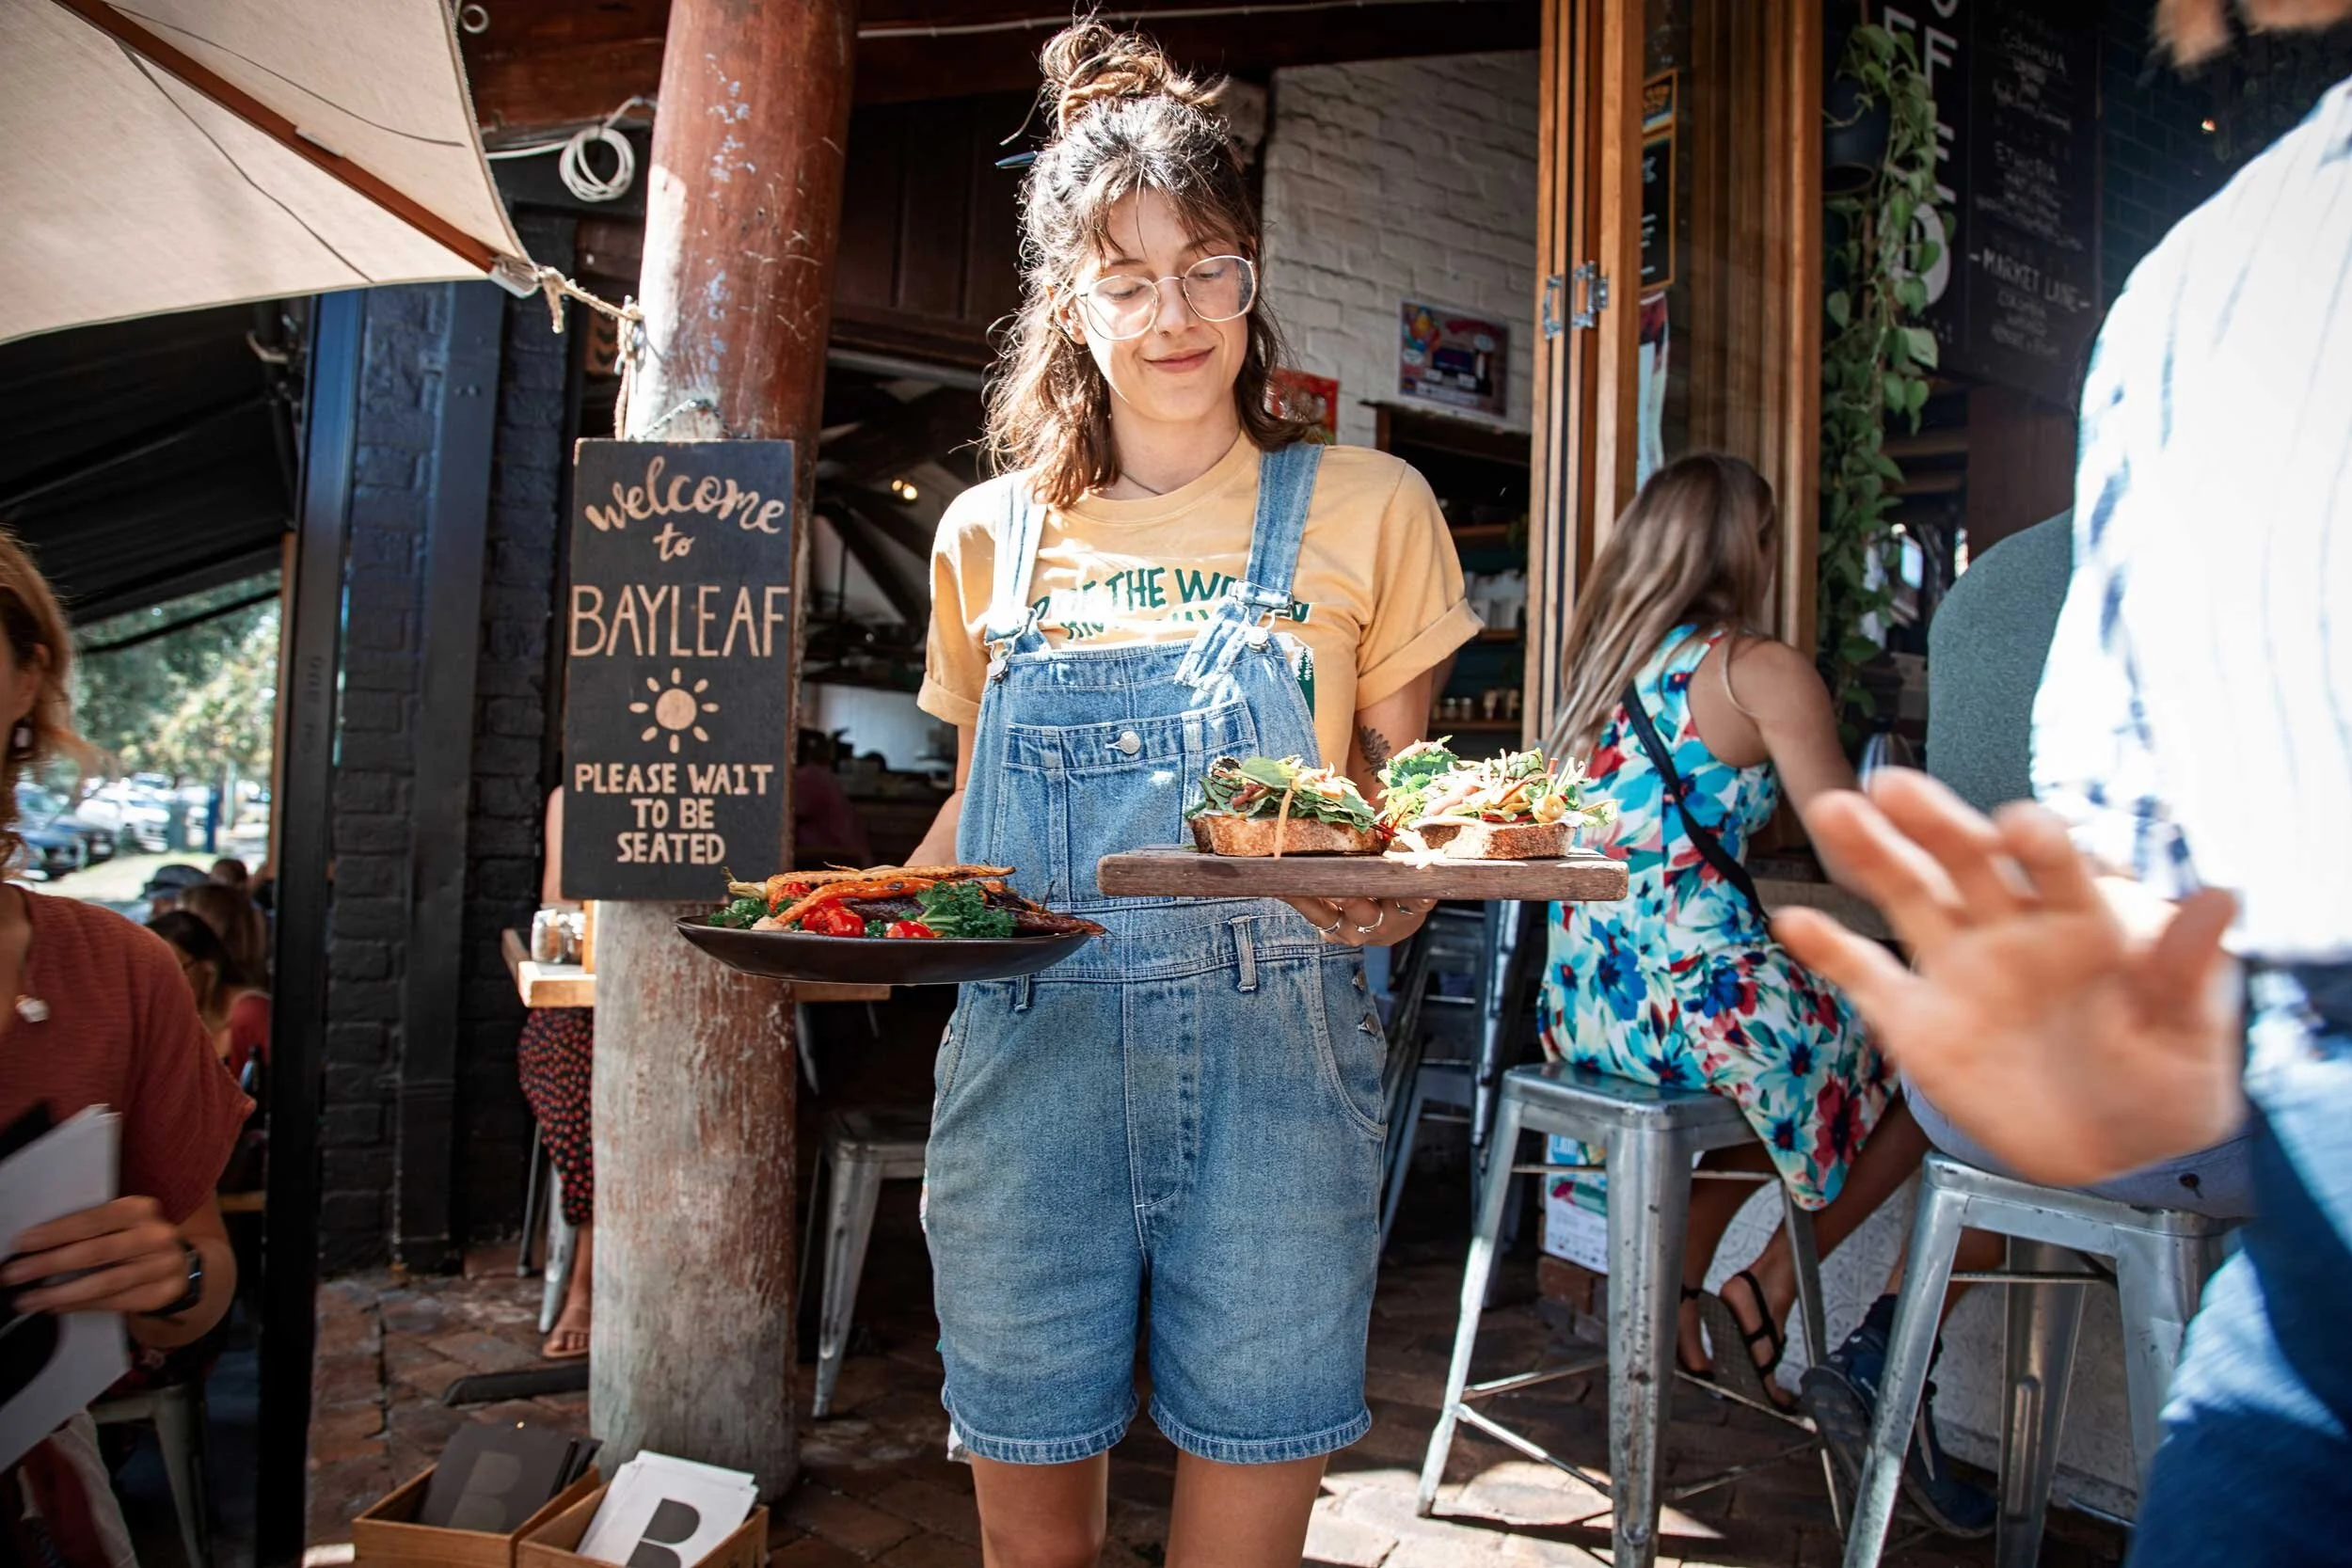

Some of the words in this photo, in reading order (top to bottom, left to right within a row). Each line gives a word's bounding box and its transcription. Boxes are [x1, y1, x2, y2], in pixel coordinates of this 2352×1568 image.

[652, 521, 696, 562] to
[1104, 566, 1167, 612] THE
[569, 584, 791, 657] BAYLEAF
[574, 763, 677, 795] PLEASE
[687, 763, 774, 796] WAIT
[630, 798, 669, 830] TO
[678, 798, 716, 831] BE
[615, 832, 727, 866] SEATED
